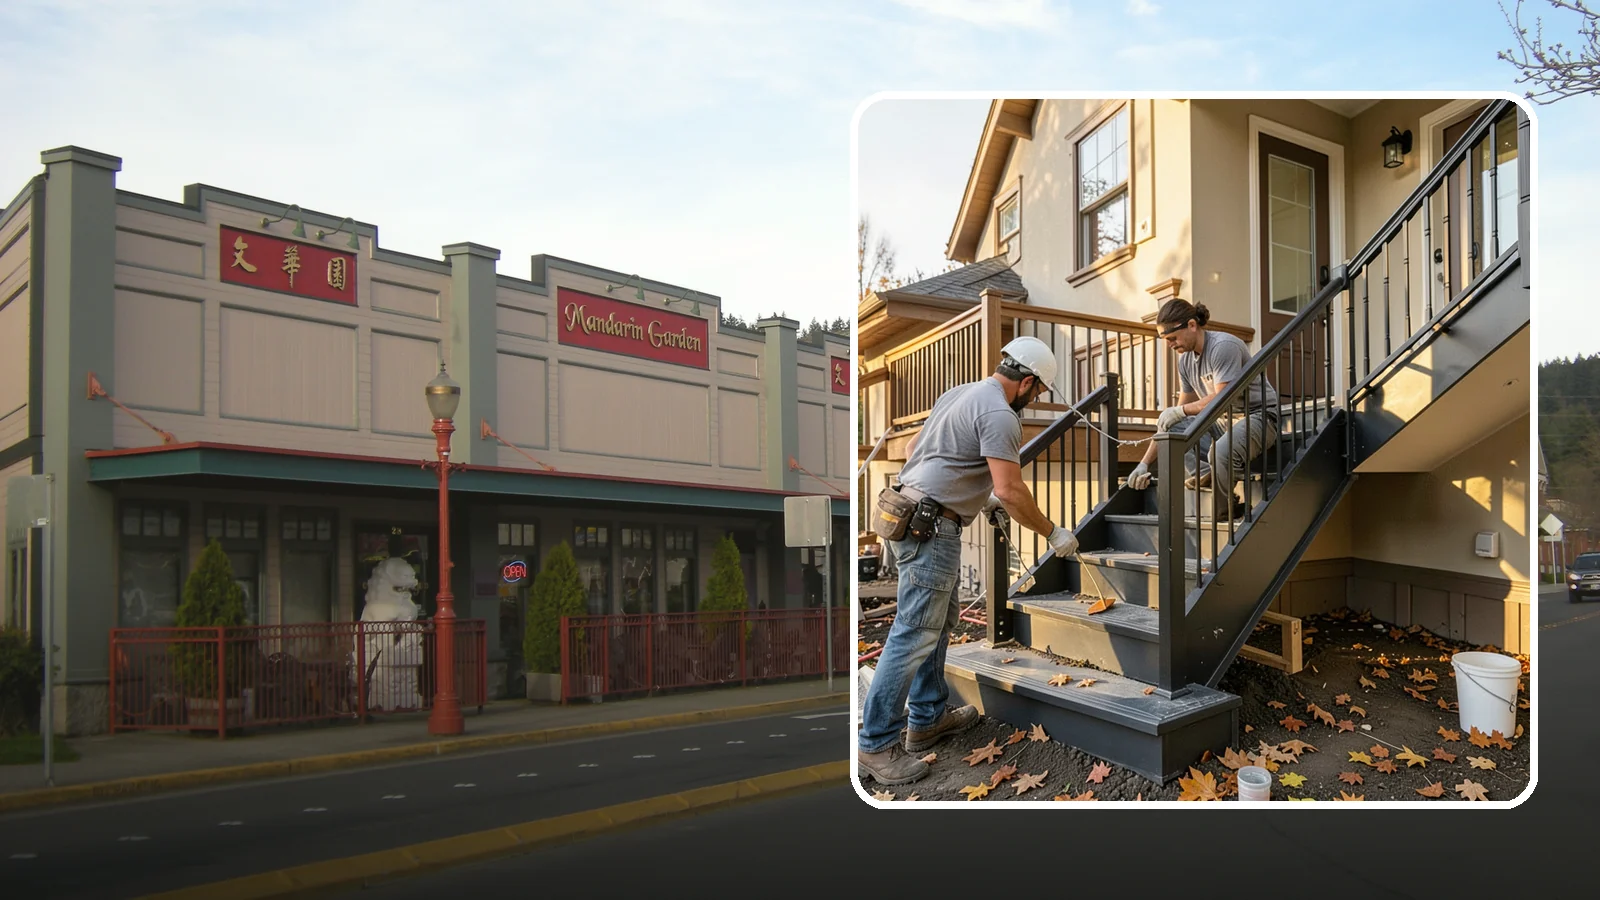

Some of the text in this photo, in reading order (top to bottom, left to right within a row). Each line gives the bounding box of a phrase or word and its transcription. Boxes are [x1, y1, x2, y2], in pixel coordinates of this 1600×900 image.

[231, 236, 346, 291] 文華園
[564, 302, 701, 352] Mandarin Garden
[503, 565, 527, 578] OPEN
